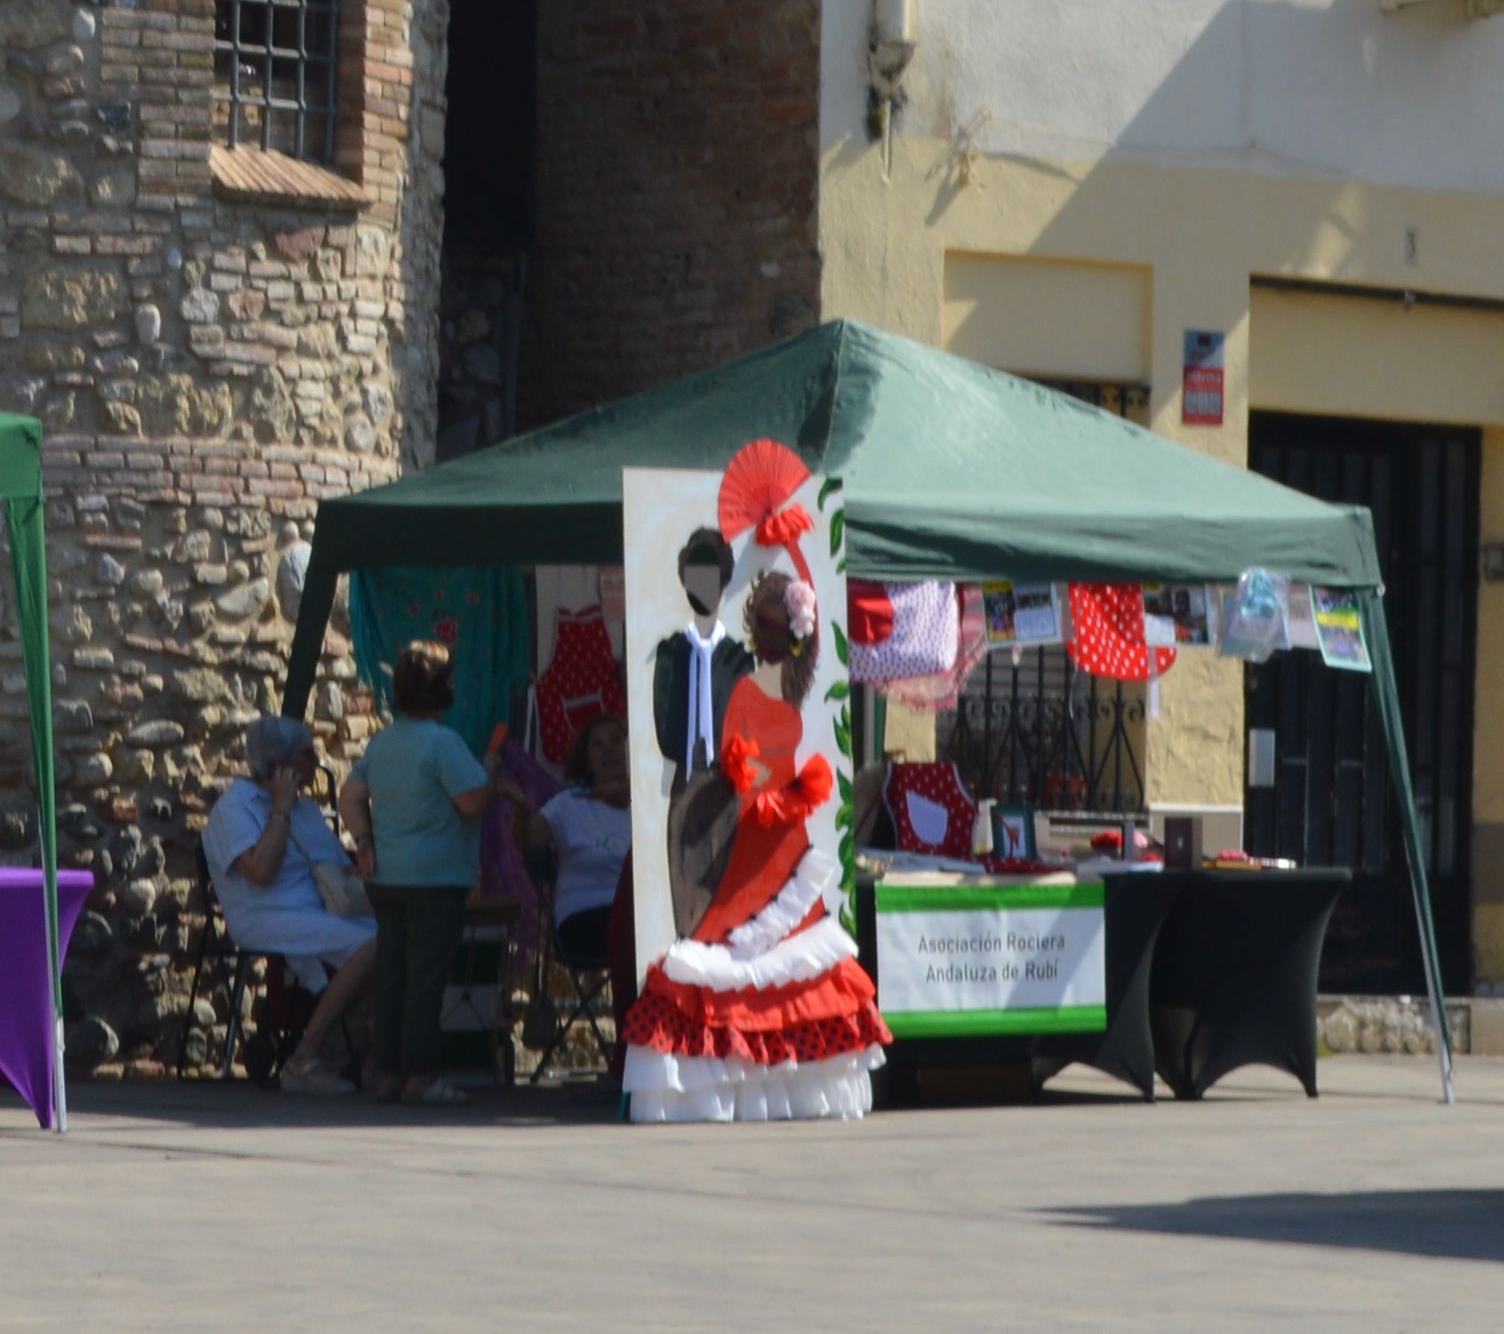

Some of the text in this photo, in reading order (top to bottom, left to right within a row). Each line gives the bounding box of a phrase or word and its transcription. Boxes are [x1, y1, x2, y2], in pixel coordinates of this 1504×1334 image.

[918, 931, 1065, 954] Asociación Rociera
[926, 958, 1058, 983] Andaluza de Rubí
